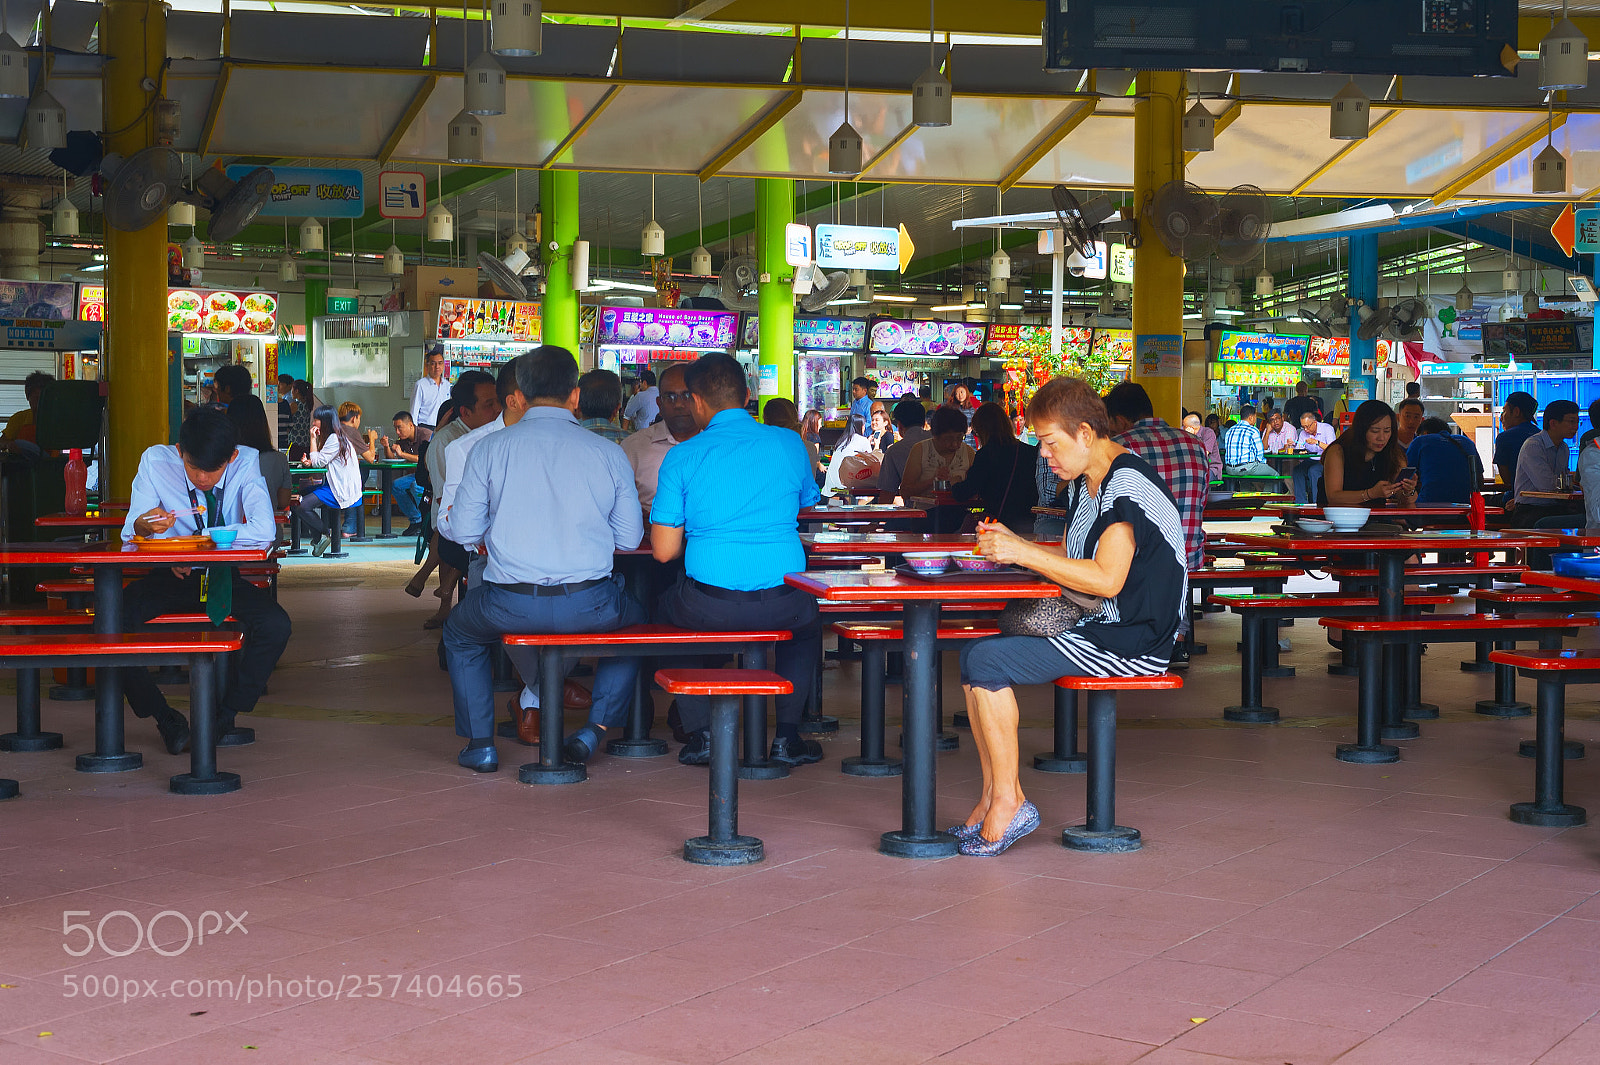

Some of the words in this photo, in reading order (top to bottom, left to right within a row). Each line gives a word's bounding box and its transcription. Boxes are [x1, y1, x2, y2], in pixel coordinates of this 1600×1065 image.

[316, 184, 360, 200] 收放处
[334, 300, 352, 311] EXIT
[8, 328, 54, 339] NON-HALAL
